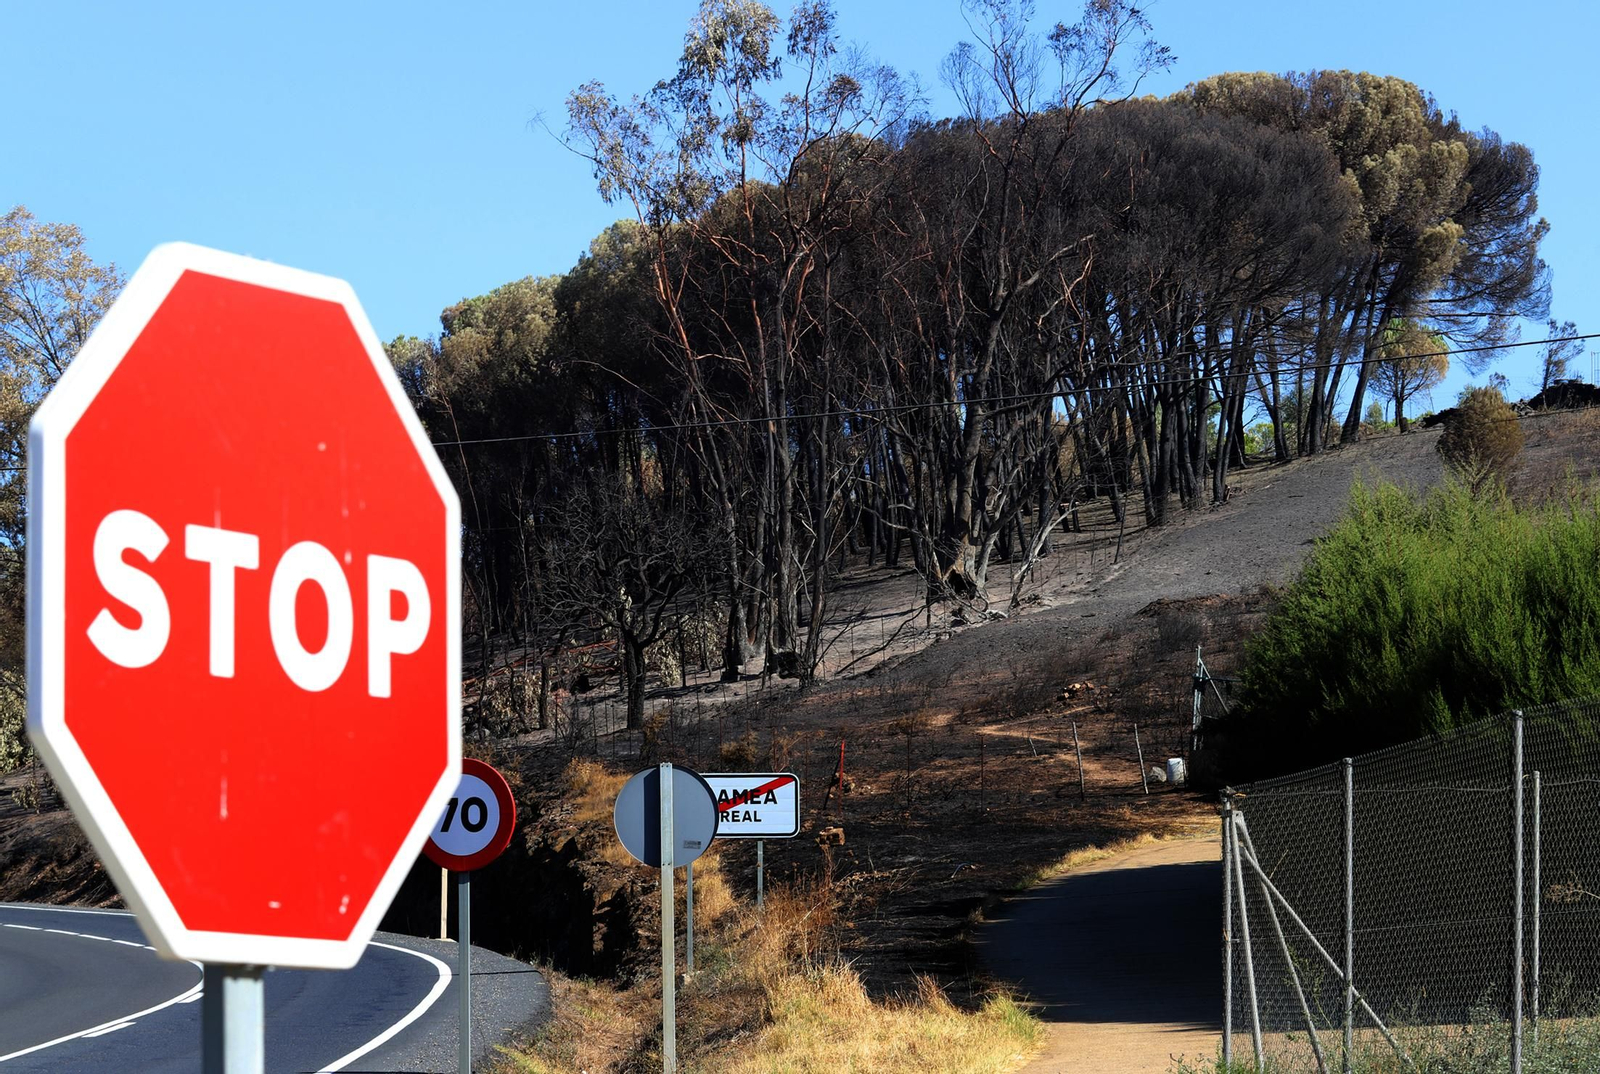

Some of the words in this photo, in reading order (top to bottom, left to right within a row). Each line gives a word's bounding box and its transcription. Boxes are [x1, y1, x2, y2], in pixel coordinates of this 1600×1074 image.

[86, 509, 431, 698] STOP
[440, 797, 488, 832] 70
[720, 811, 762, 822] REAL
